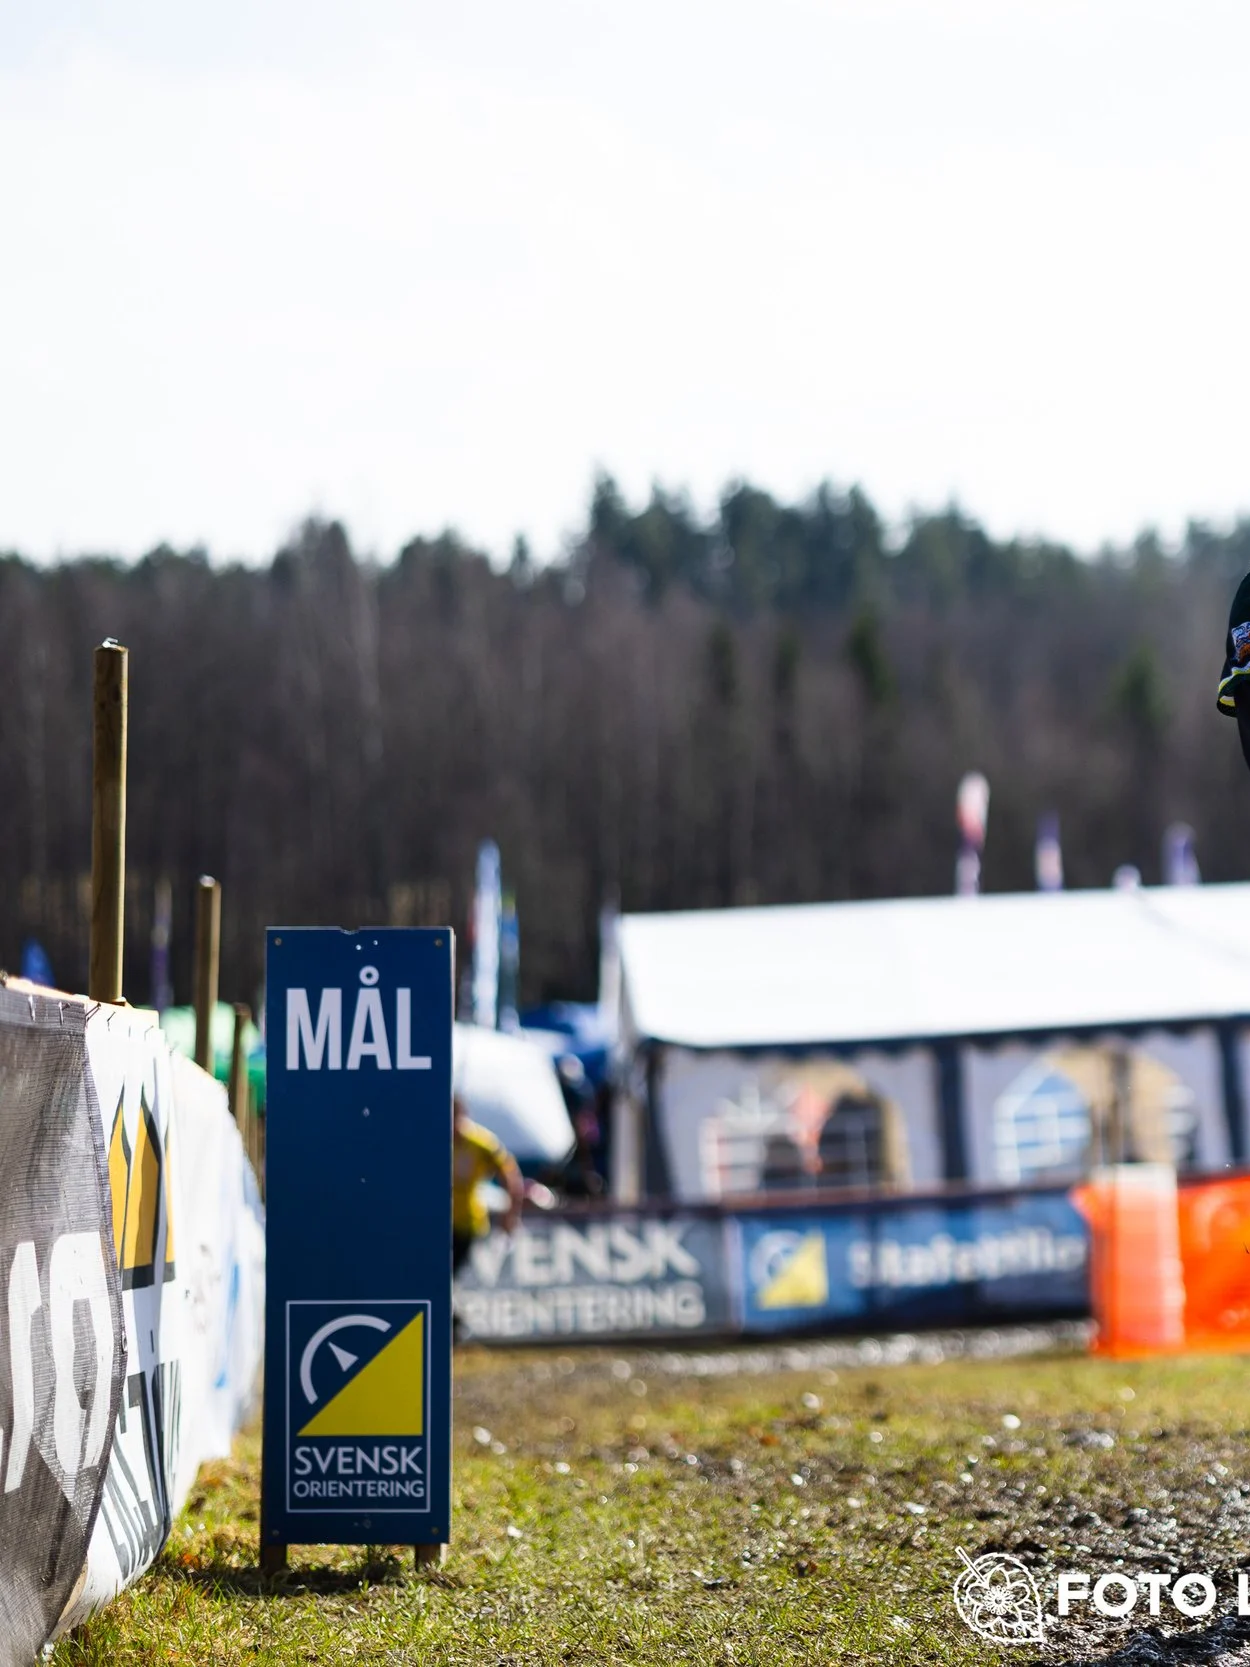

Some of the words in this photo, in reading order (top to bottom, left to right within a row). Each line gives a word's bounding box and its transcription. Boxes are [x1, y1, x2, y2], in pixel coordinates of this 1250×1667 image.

[286, 965, 432, 1071] MÅL
[468, 1220, 700, 1287] VENSK
[456, 1278, 707, 1337] RIENTERING
[293, 1479, 425, 1498] ORIENTERING
[294, 1445, 424, 1476] SVENSK
